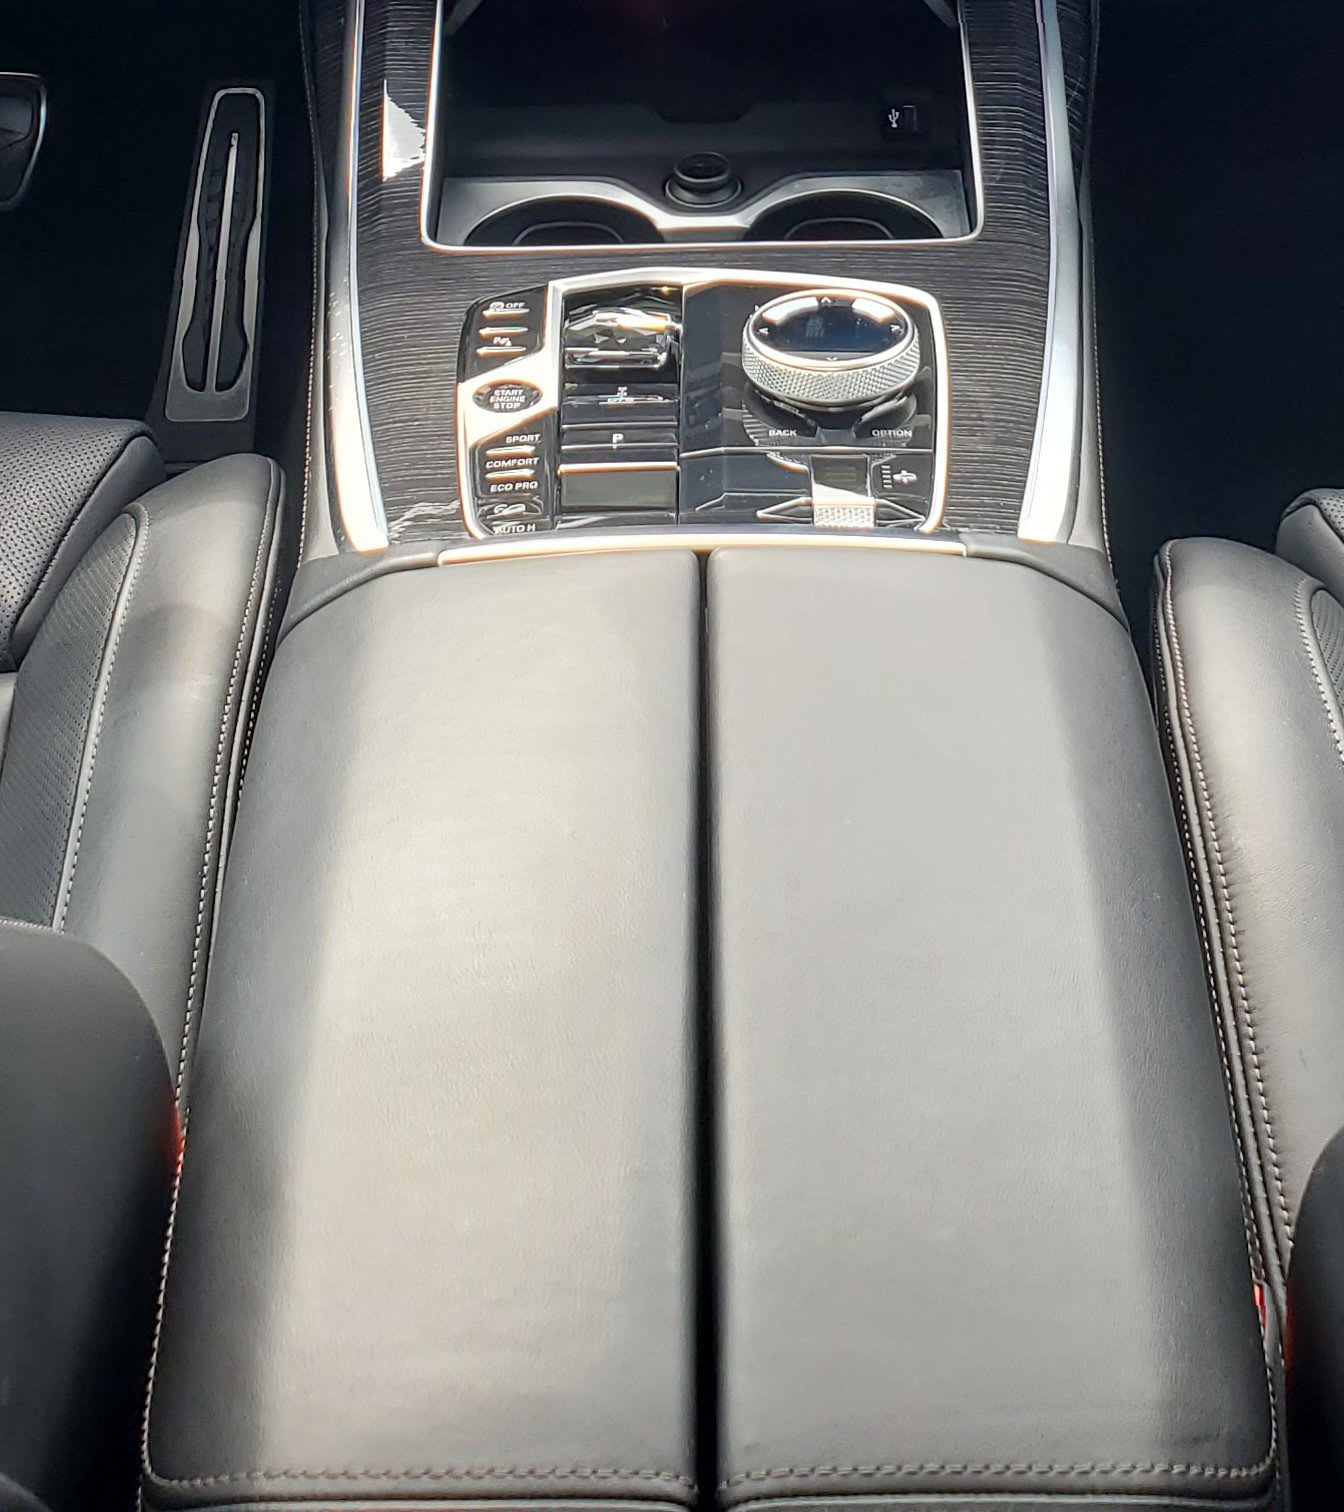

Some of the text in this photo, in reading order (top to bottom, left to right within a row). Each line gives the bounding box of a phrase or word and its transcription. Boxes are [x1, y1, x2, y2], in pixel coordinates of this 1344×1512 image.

[768, 429, 913, 437] BACK OPTION
[505, 434, 541, 444] SPORT
[612, 433, 624, 446] P
[486, 457, 540, 469] COMFORT
[490, 481, 539, 493] ECO PRO
[526, 523, 536, 532] H
